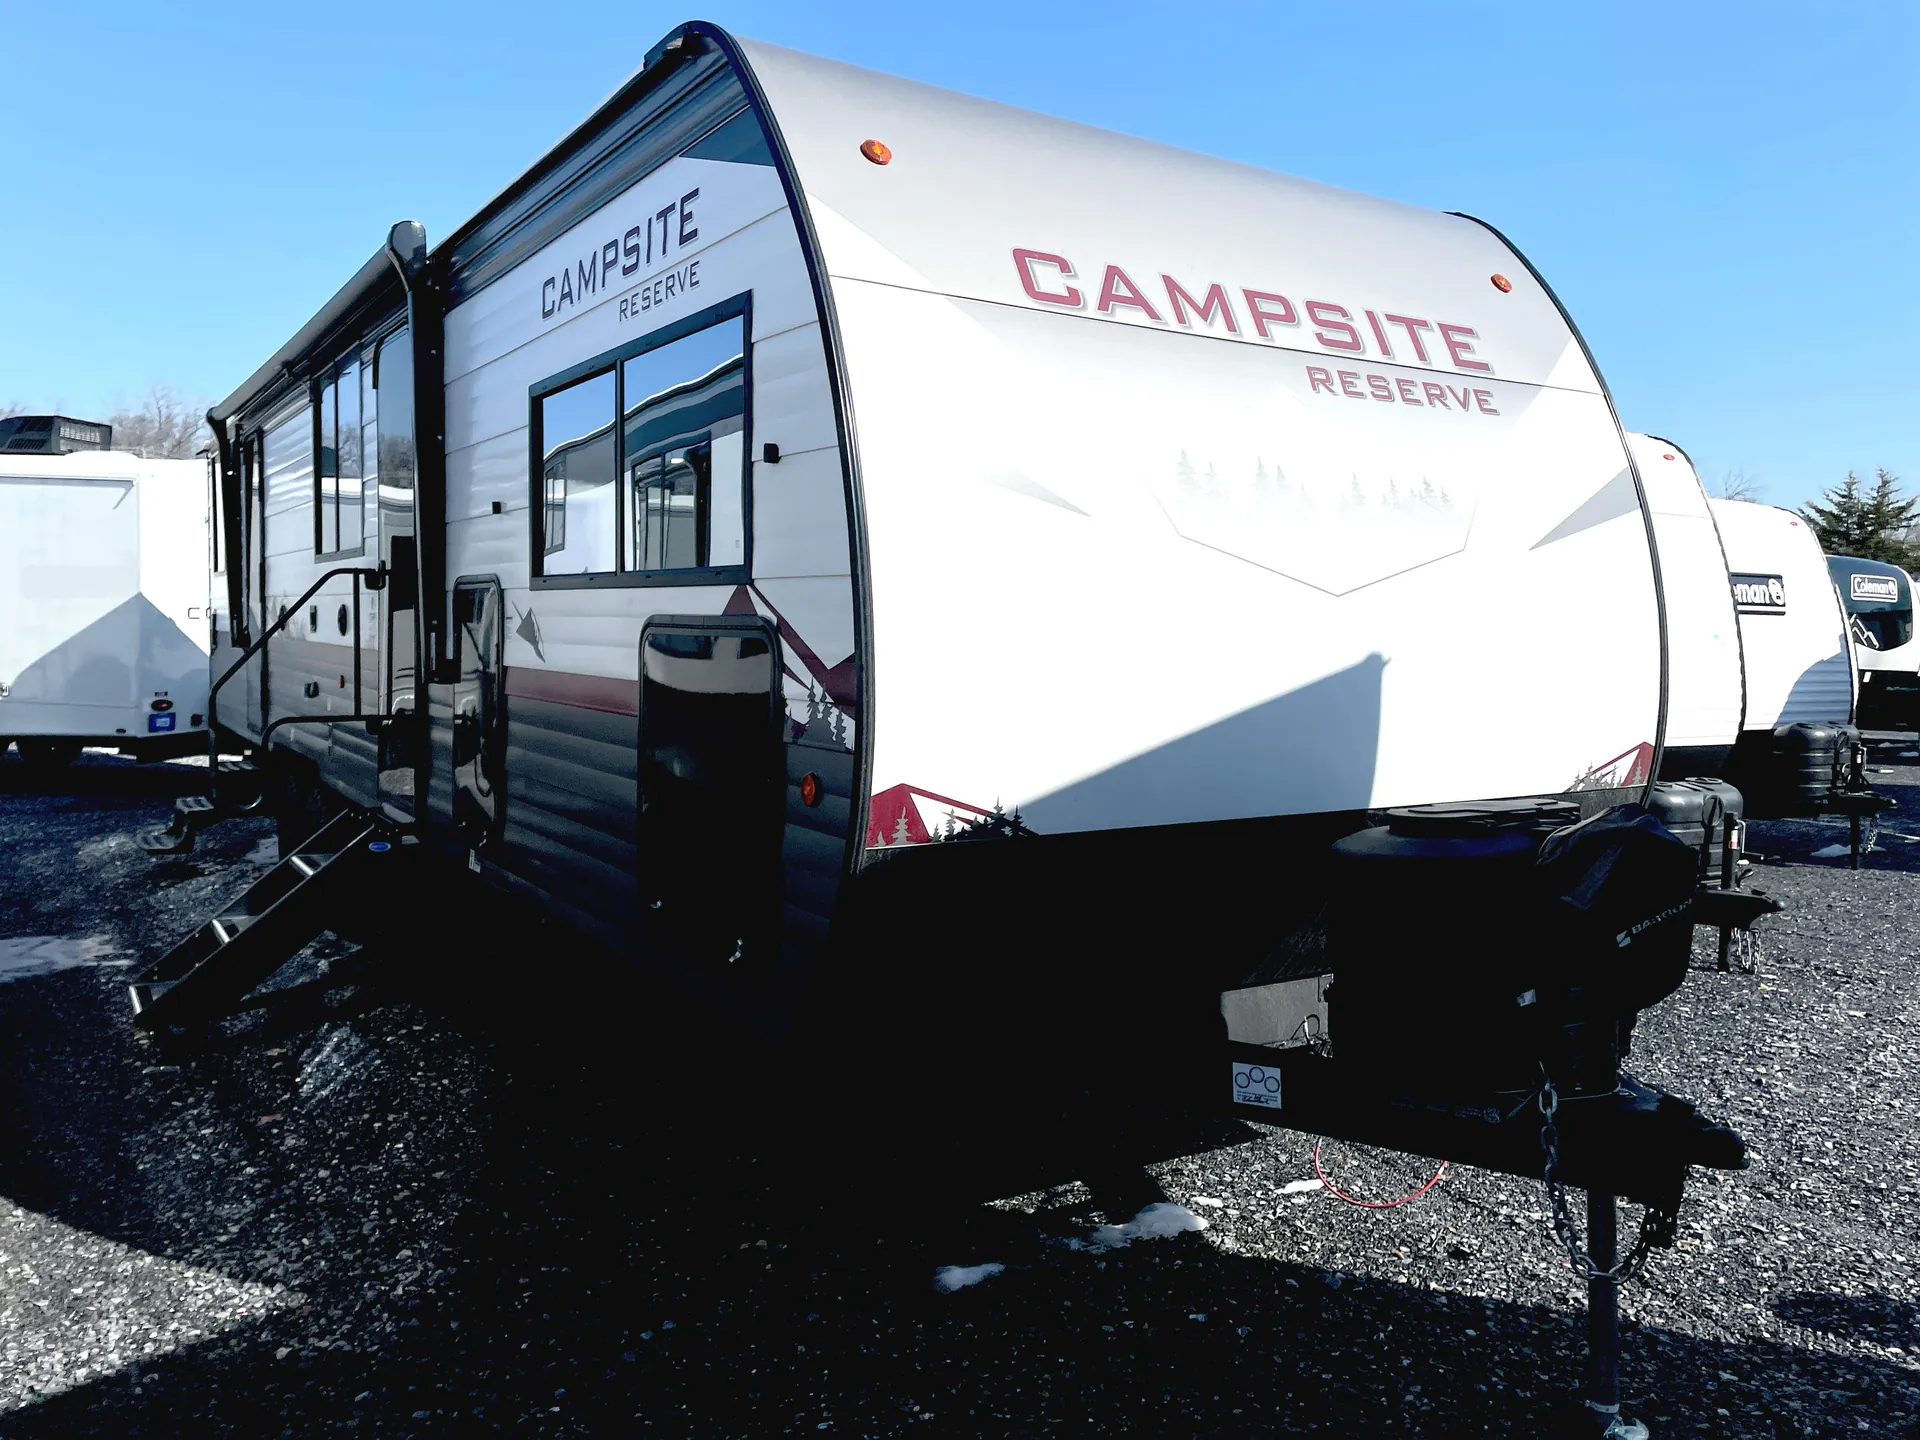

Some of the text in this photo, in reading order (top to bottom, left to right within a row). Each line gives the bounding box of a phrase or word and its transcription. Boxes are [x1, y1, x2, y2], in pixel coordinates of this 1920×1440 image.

[541, 187, 700, 320] CAMPSITE
[618, 260, 700, 322] RESERVE
[1011, 247, 1494, 373] CAMPSITE
[1305, 364, 1500, 416] RESERVE
[1733, 583, 1770, 604] man
[1854, 577, 1889, 595] Coleman
